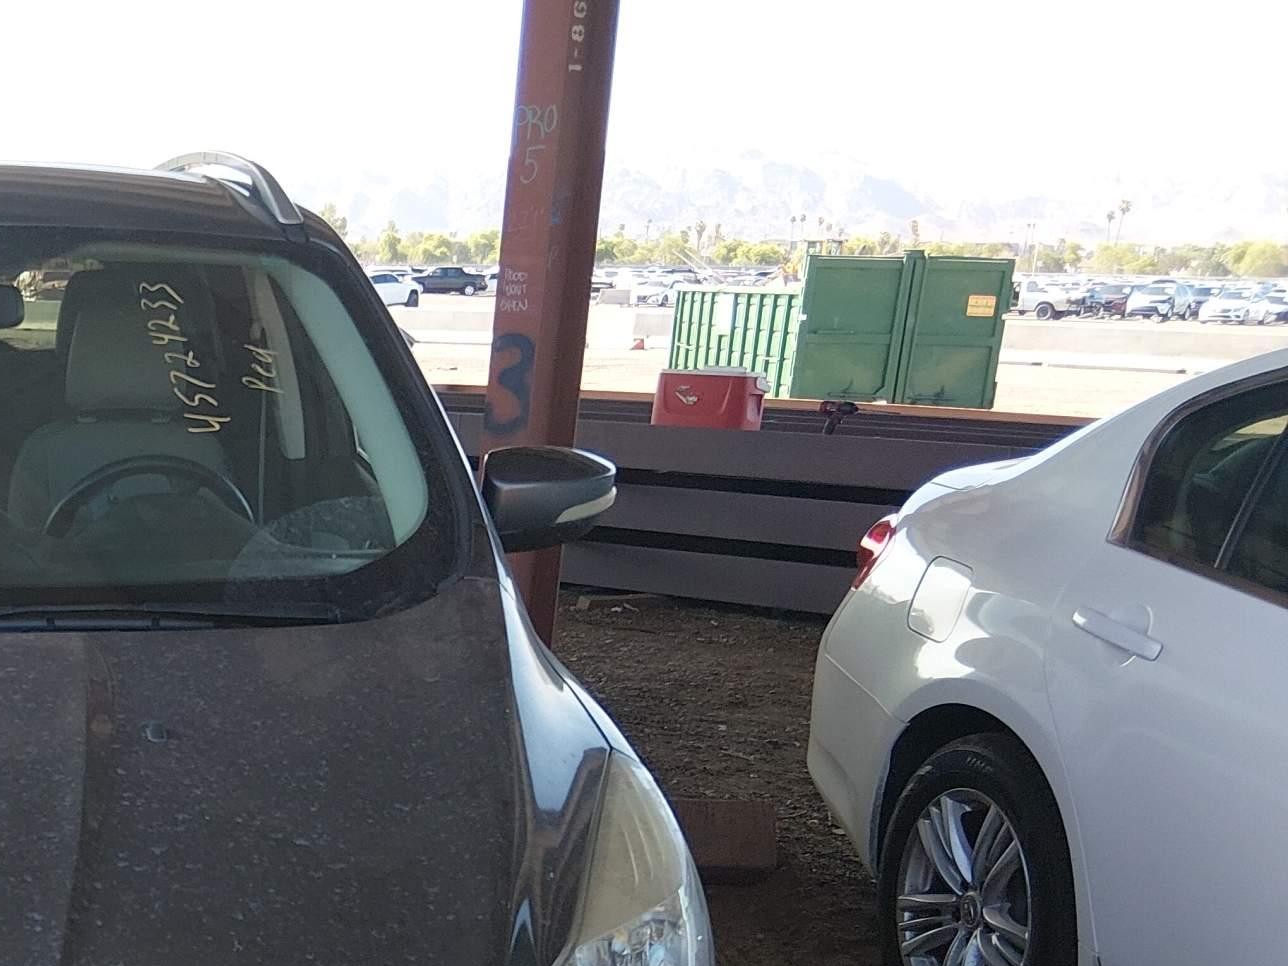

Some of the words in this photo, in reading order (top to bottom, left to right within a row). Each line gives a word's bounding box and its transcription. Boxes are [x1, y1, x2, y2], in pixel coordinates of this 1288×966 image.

[513, 104, 557, 144] PRO
[519, 145, 546, 184] 5
[484, 332, 535, 436] 3
